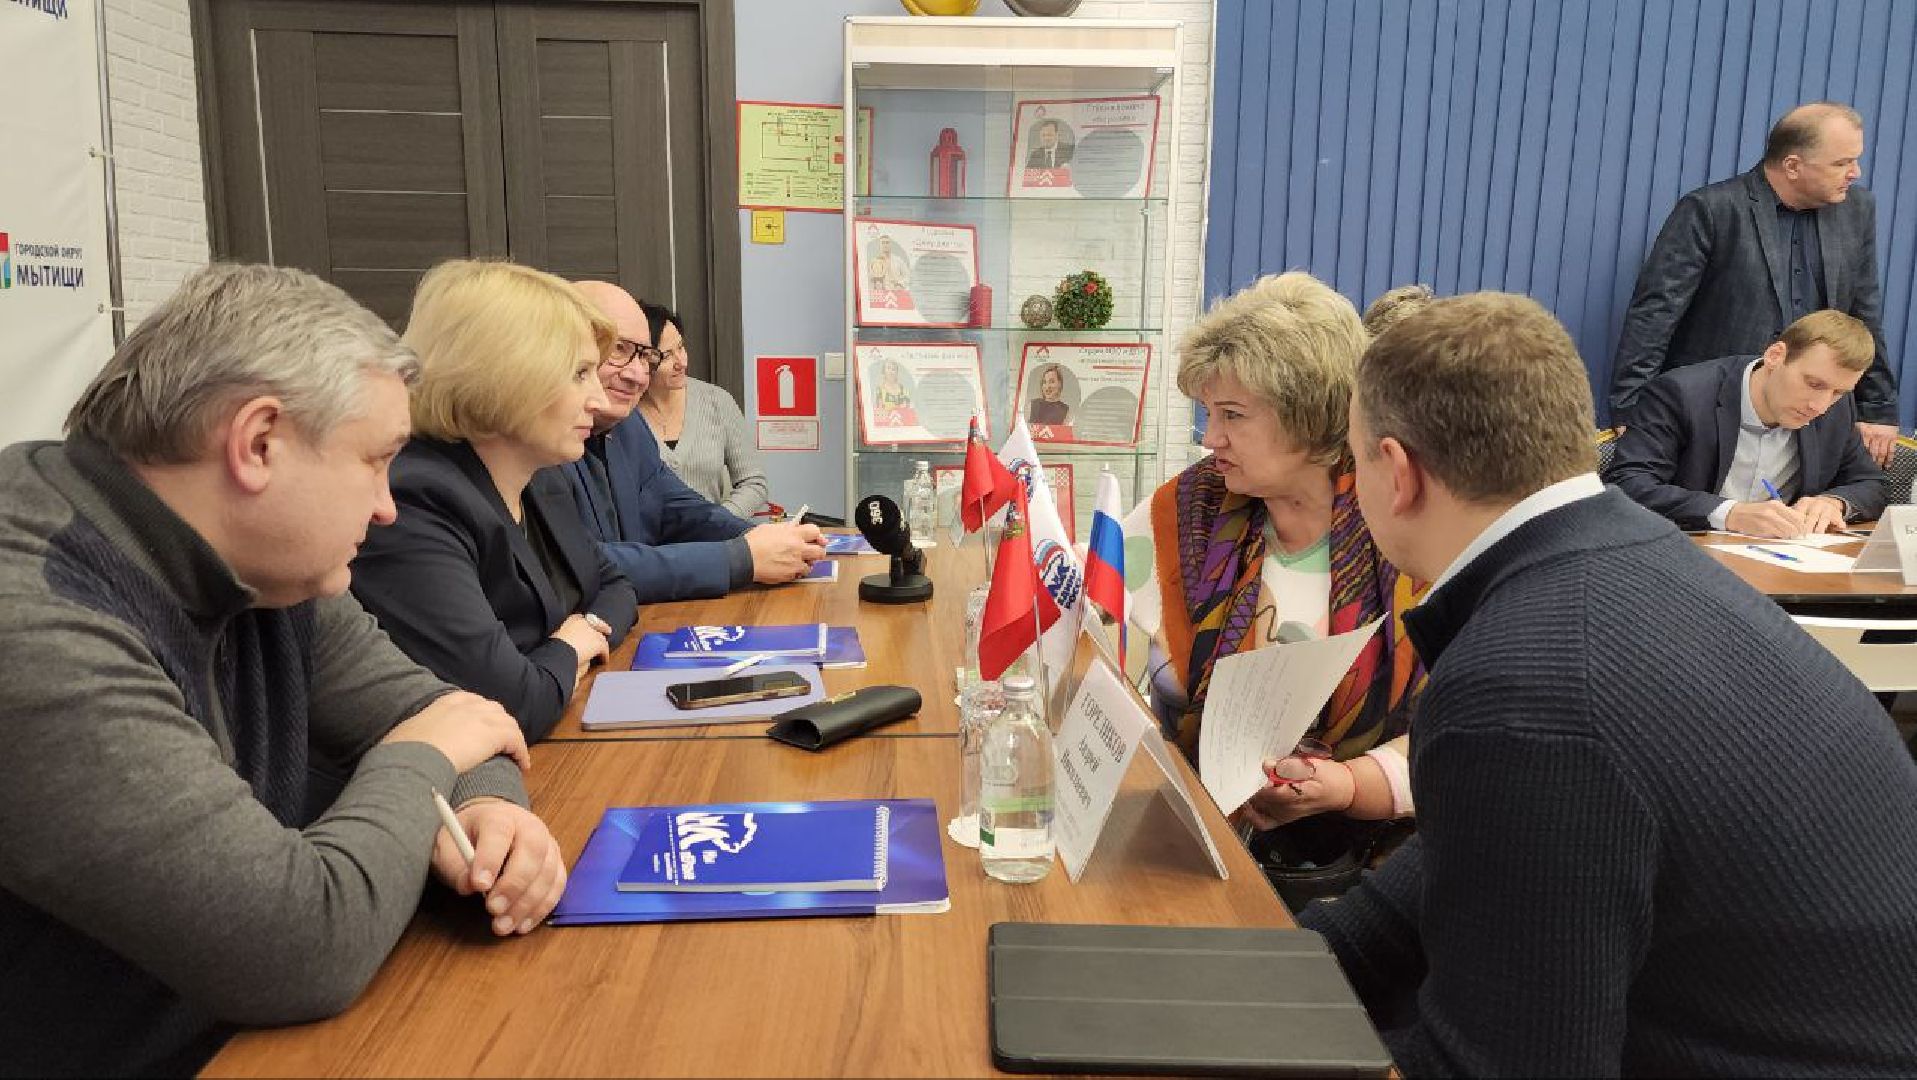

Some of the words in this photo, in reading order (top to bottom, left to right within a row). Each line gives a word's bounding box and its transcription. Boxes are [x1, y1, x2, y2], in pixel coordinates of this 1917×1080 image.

[15, 242, 59, 258] ГОРОДСКОЙ
[17, 264, 83, 292] МЫТИЩИ
[869, 501, 883, 525] 360
